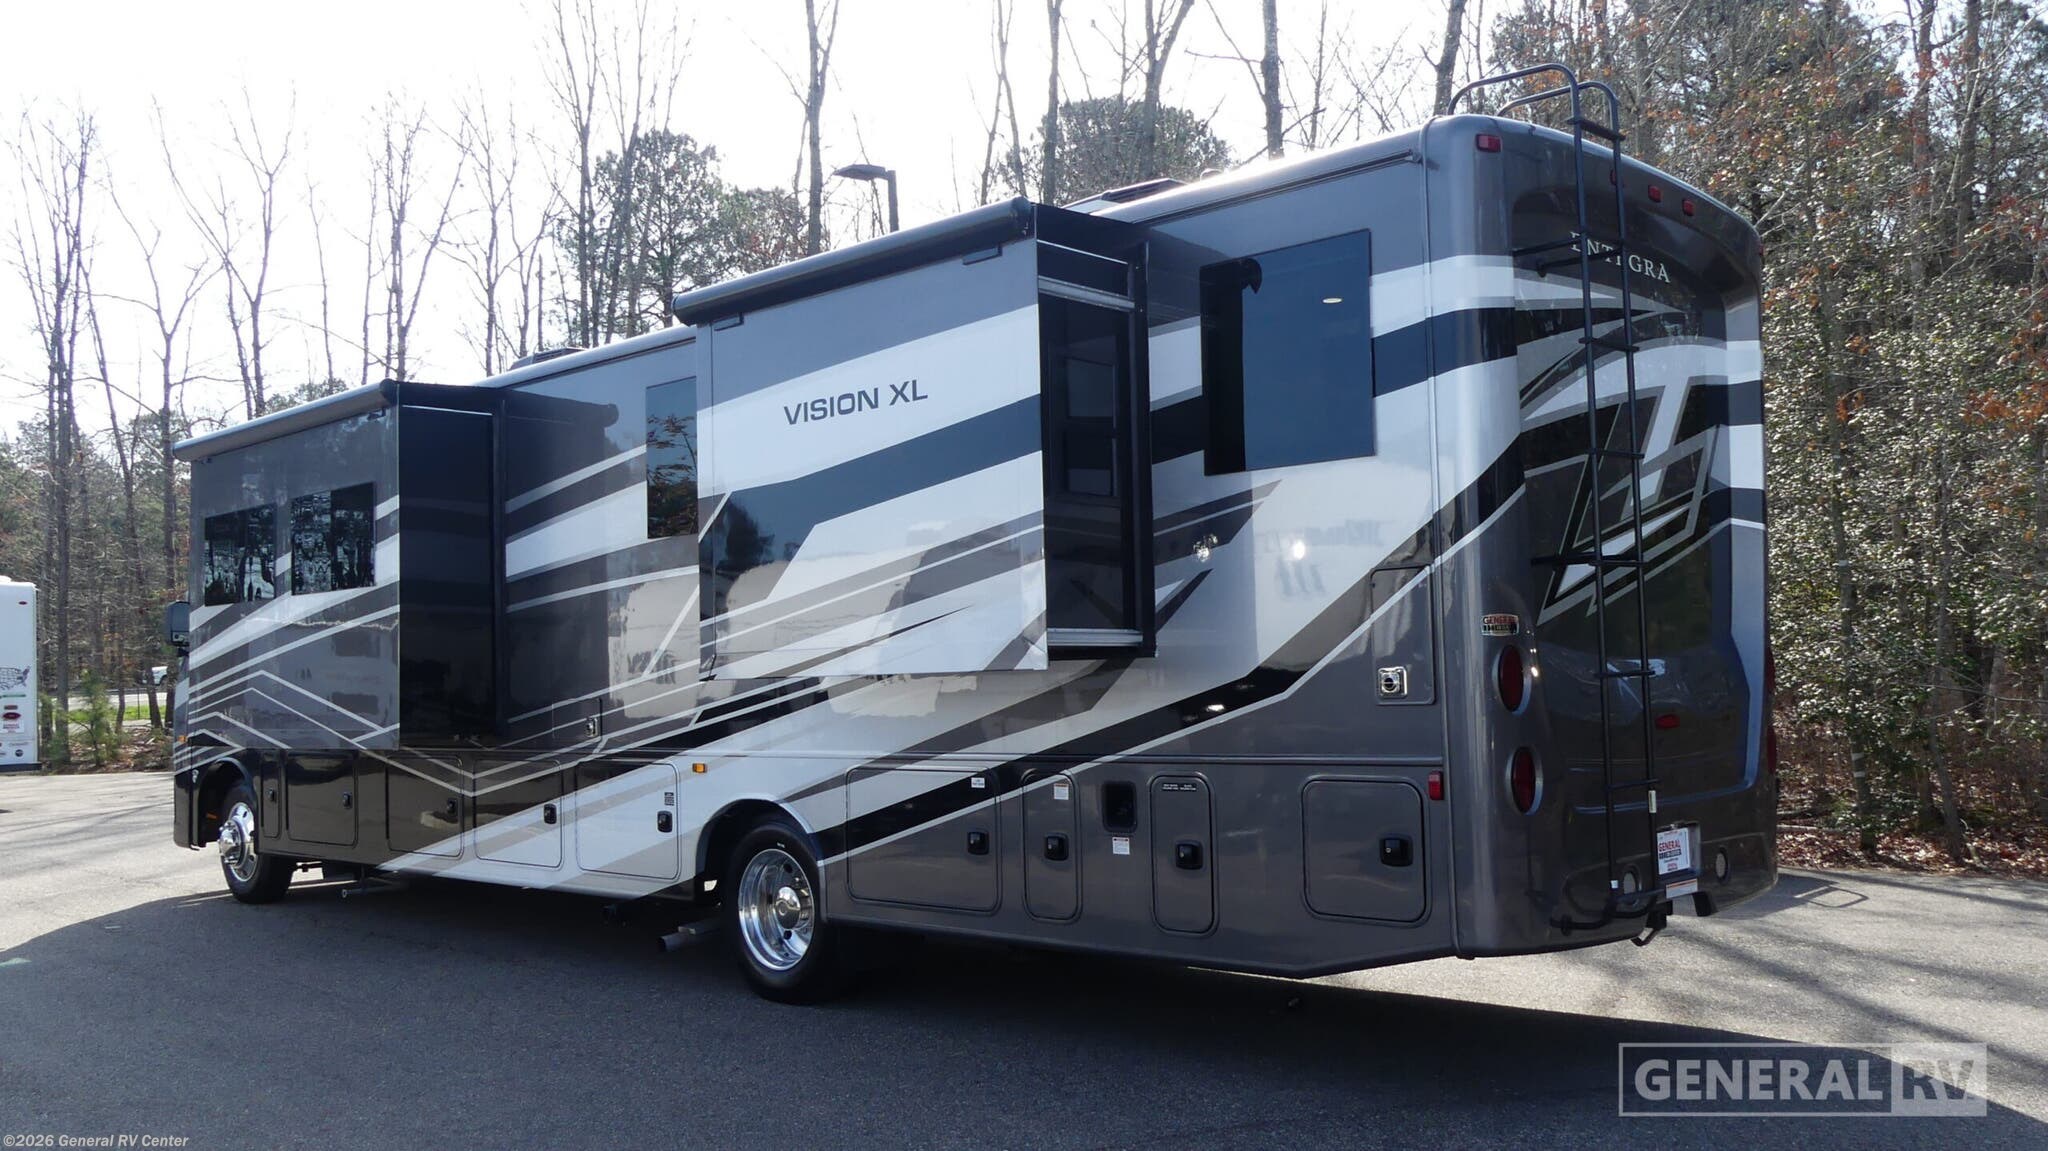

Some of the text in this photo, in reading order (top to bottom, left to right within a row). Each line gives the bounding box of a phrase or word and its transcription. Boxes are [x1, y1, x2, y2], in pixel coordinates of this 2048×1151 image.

[1570, 231, 1671, 283] ENTGRA
[783, 379, 928, 425] VISION XL
